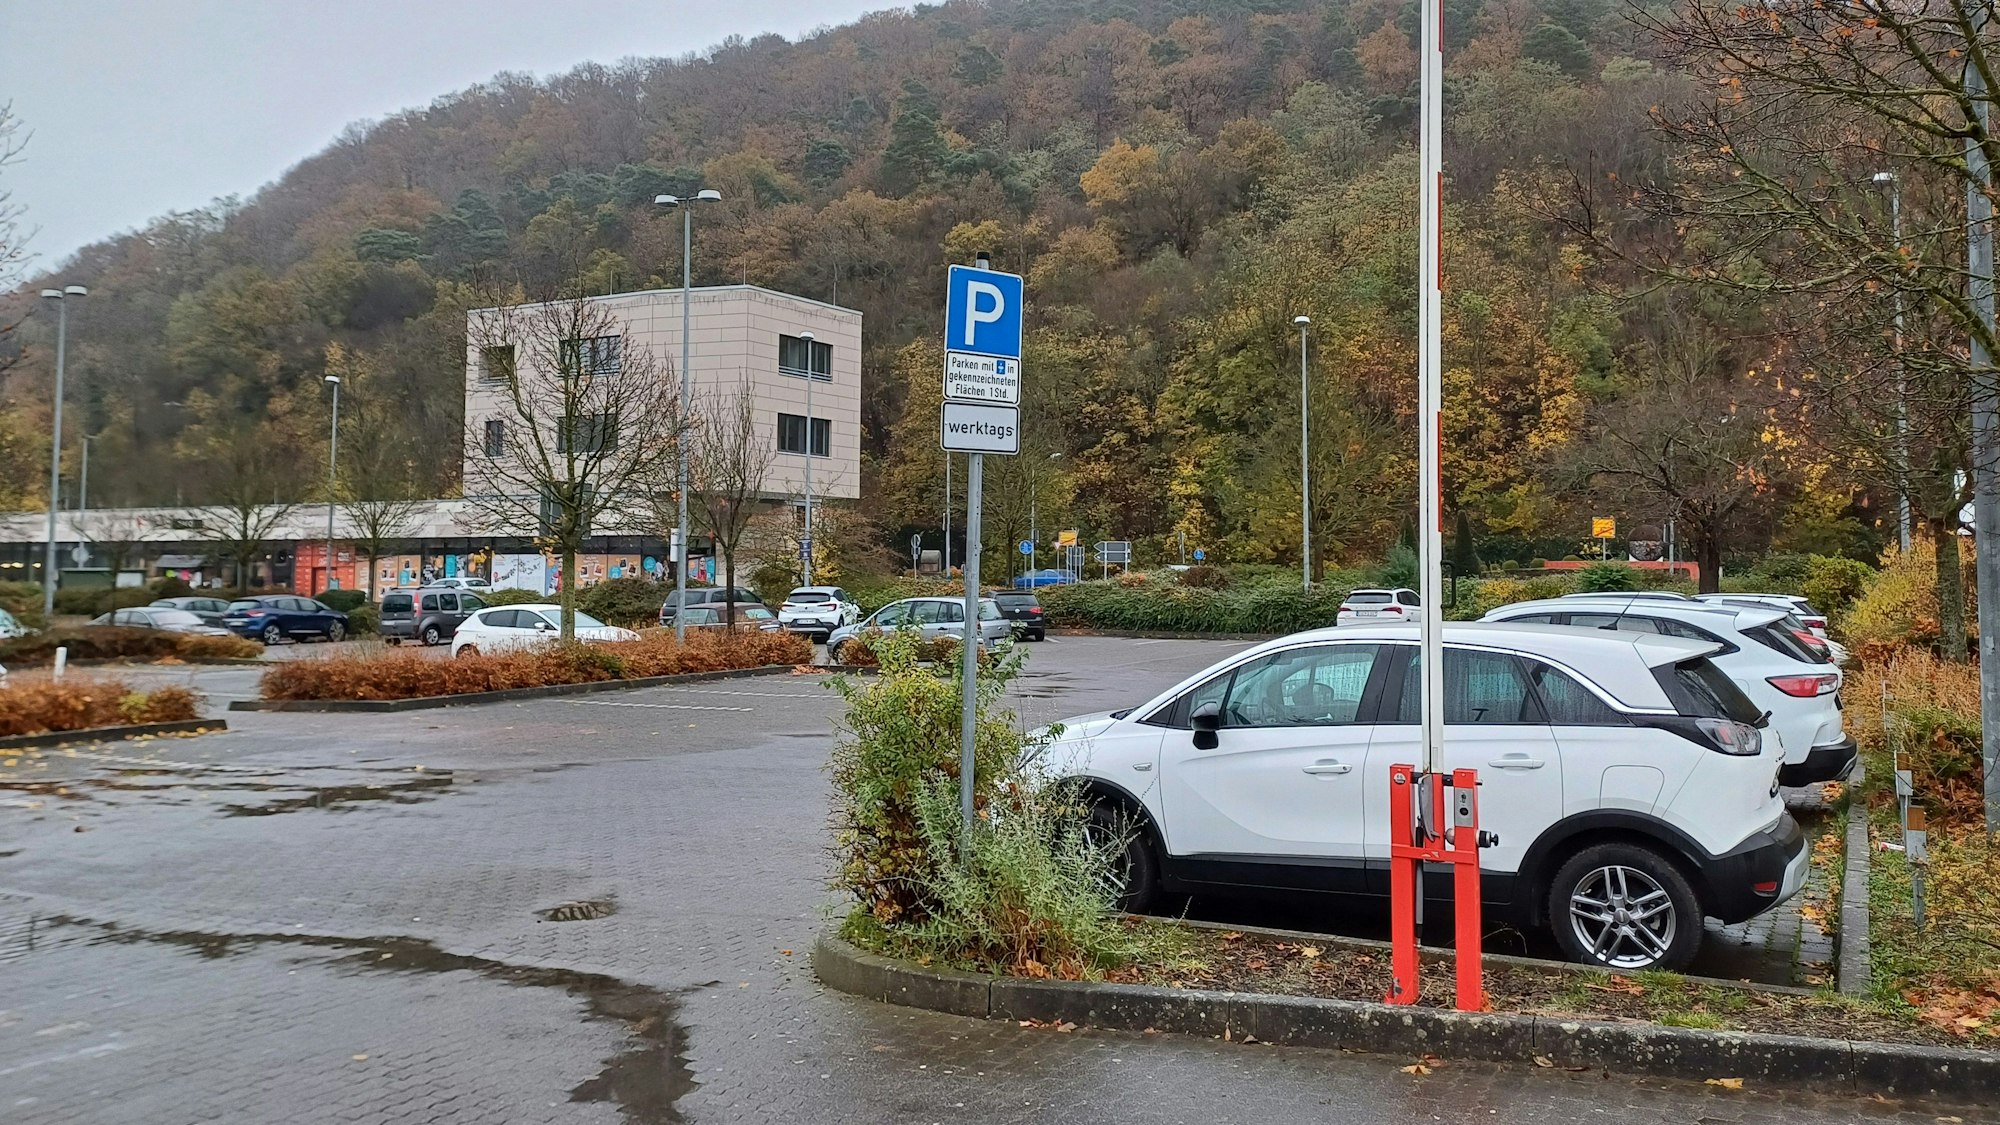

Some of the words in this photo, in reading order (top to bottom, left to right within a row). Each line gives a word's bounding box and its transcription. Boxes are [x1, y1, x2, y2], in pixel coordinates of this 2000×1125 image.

[965, 281, 1005, 346] P
[952, 357, 978, 370] Parken
[981, 362, 994, 371] mit
[1007, 364, 1014, 373] in
[949, 371, 1016, 387] gekennzeichneten
[956, 384, 985, 396] Flächen
[949, 421, 1014, 439] werktags
